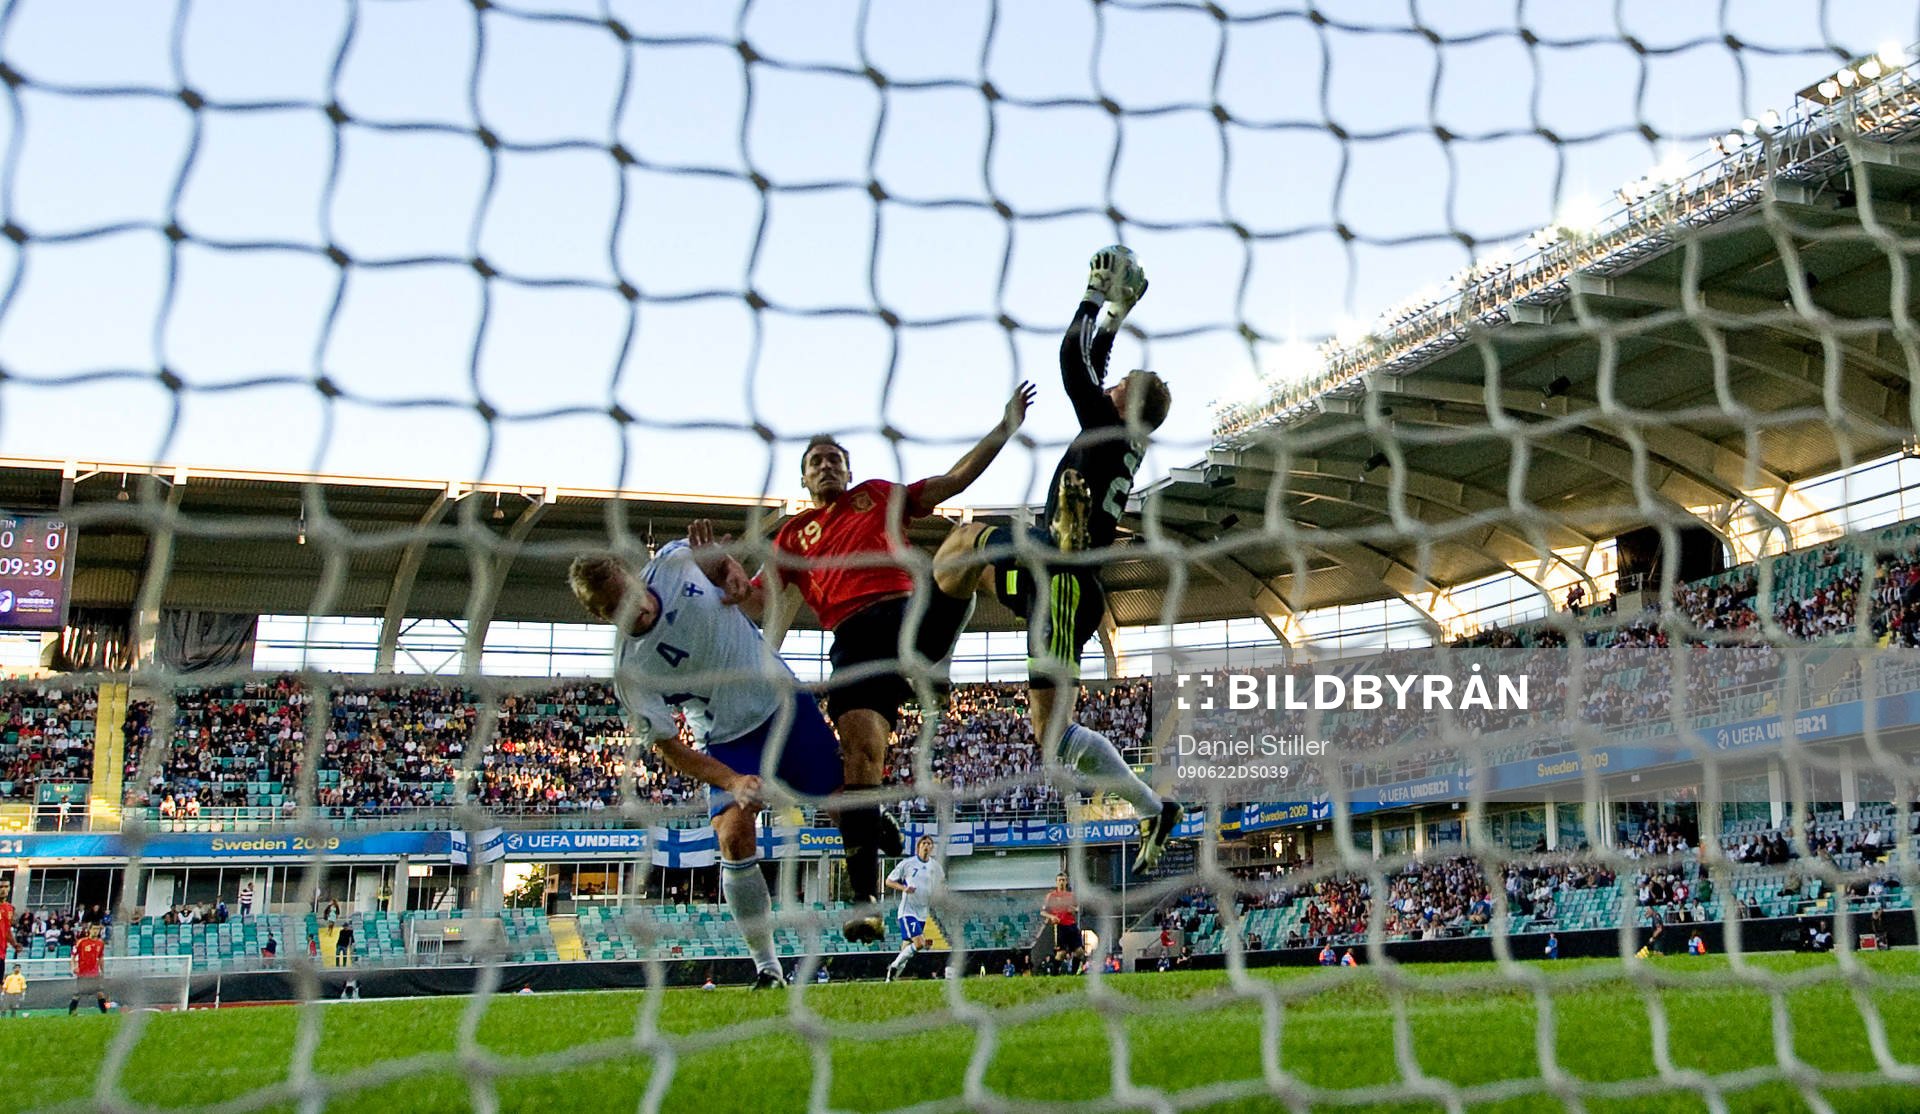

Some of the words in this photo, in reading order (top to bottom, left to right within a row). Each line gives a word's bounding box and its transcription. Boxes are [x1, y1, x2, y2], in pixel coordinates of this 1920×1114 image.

[0, 531, 14, 548] 0
[46, 533, 60, 550] 0
[797, 520, 822, 551] 19
[0, 557, 57, 577] 09:39
[656, 641, 690, 668] 4
[1732, 725, 1766, 745] UEFA
[1537, 759, 1579, 778] Sweden
[1387, 786, 1410, 803] UEFA
[1410, 780, 1449, 799] UNDER21
[1260, 809, 1289, 824] Sweden
[1289, 803, 1309, 819] 2009
[528, 834, 571, 848] UEFA
[574, 834, 648, 848] UNDER21
[1066, 825, 1101, 839] UEFA
[211, 837, 287, 851] Sweden
[911, 867, 919, 878] 7
[910, 921, 917, 933] 7
